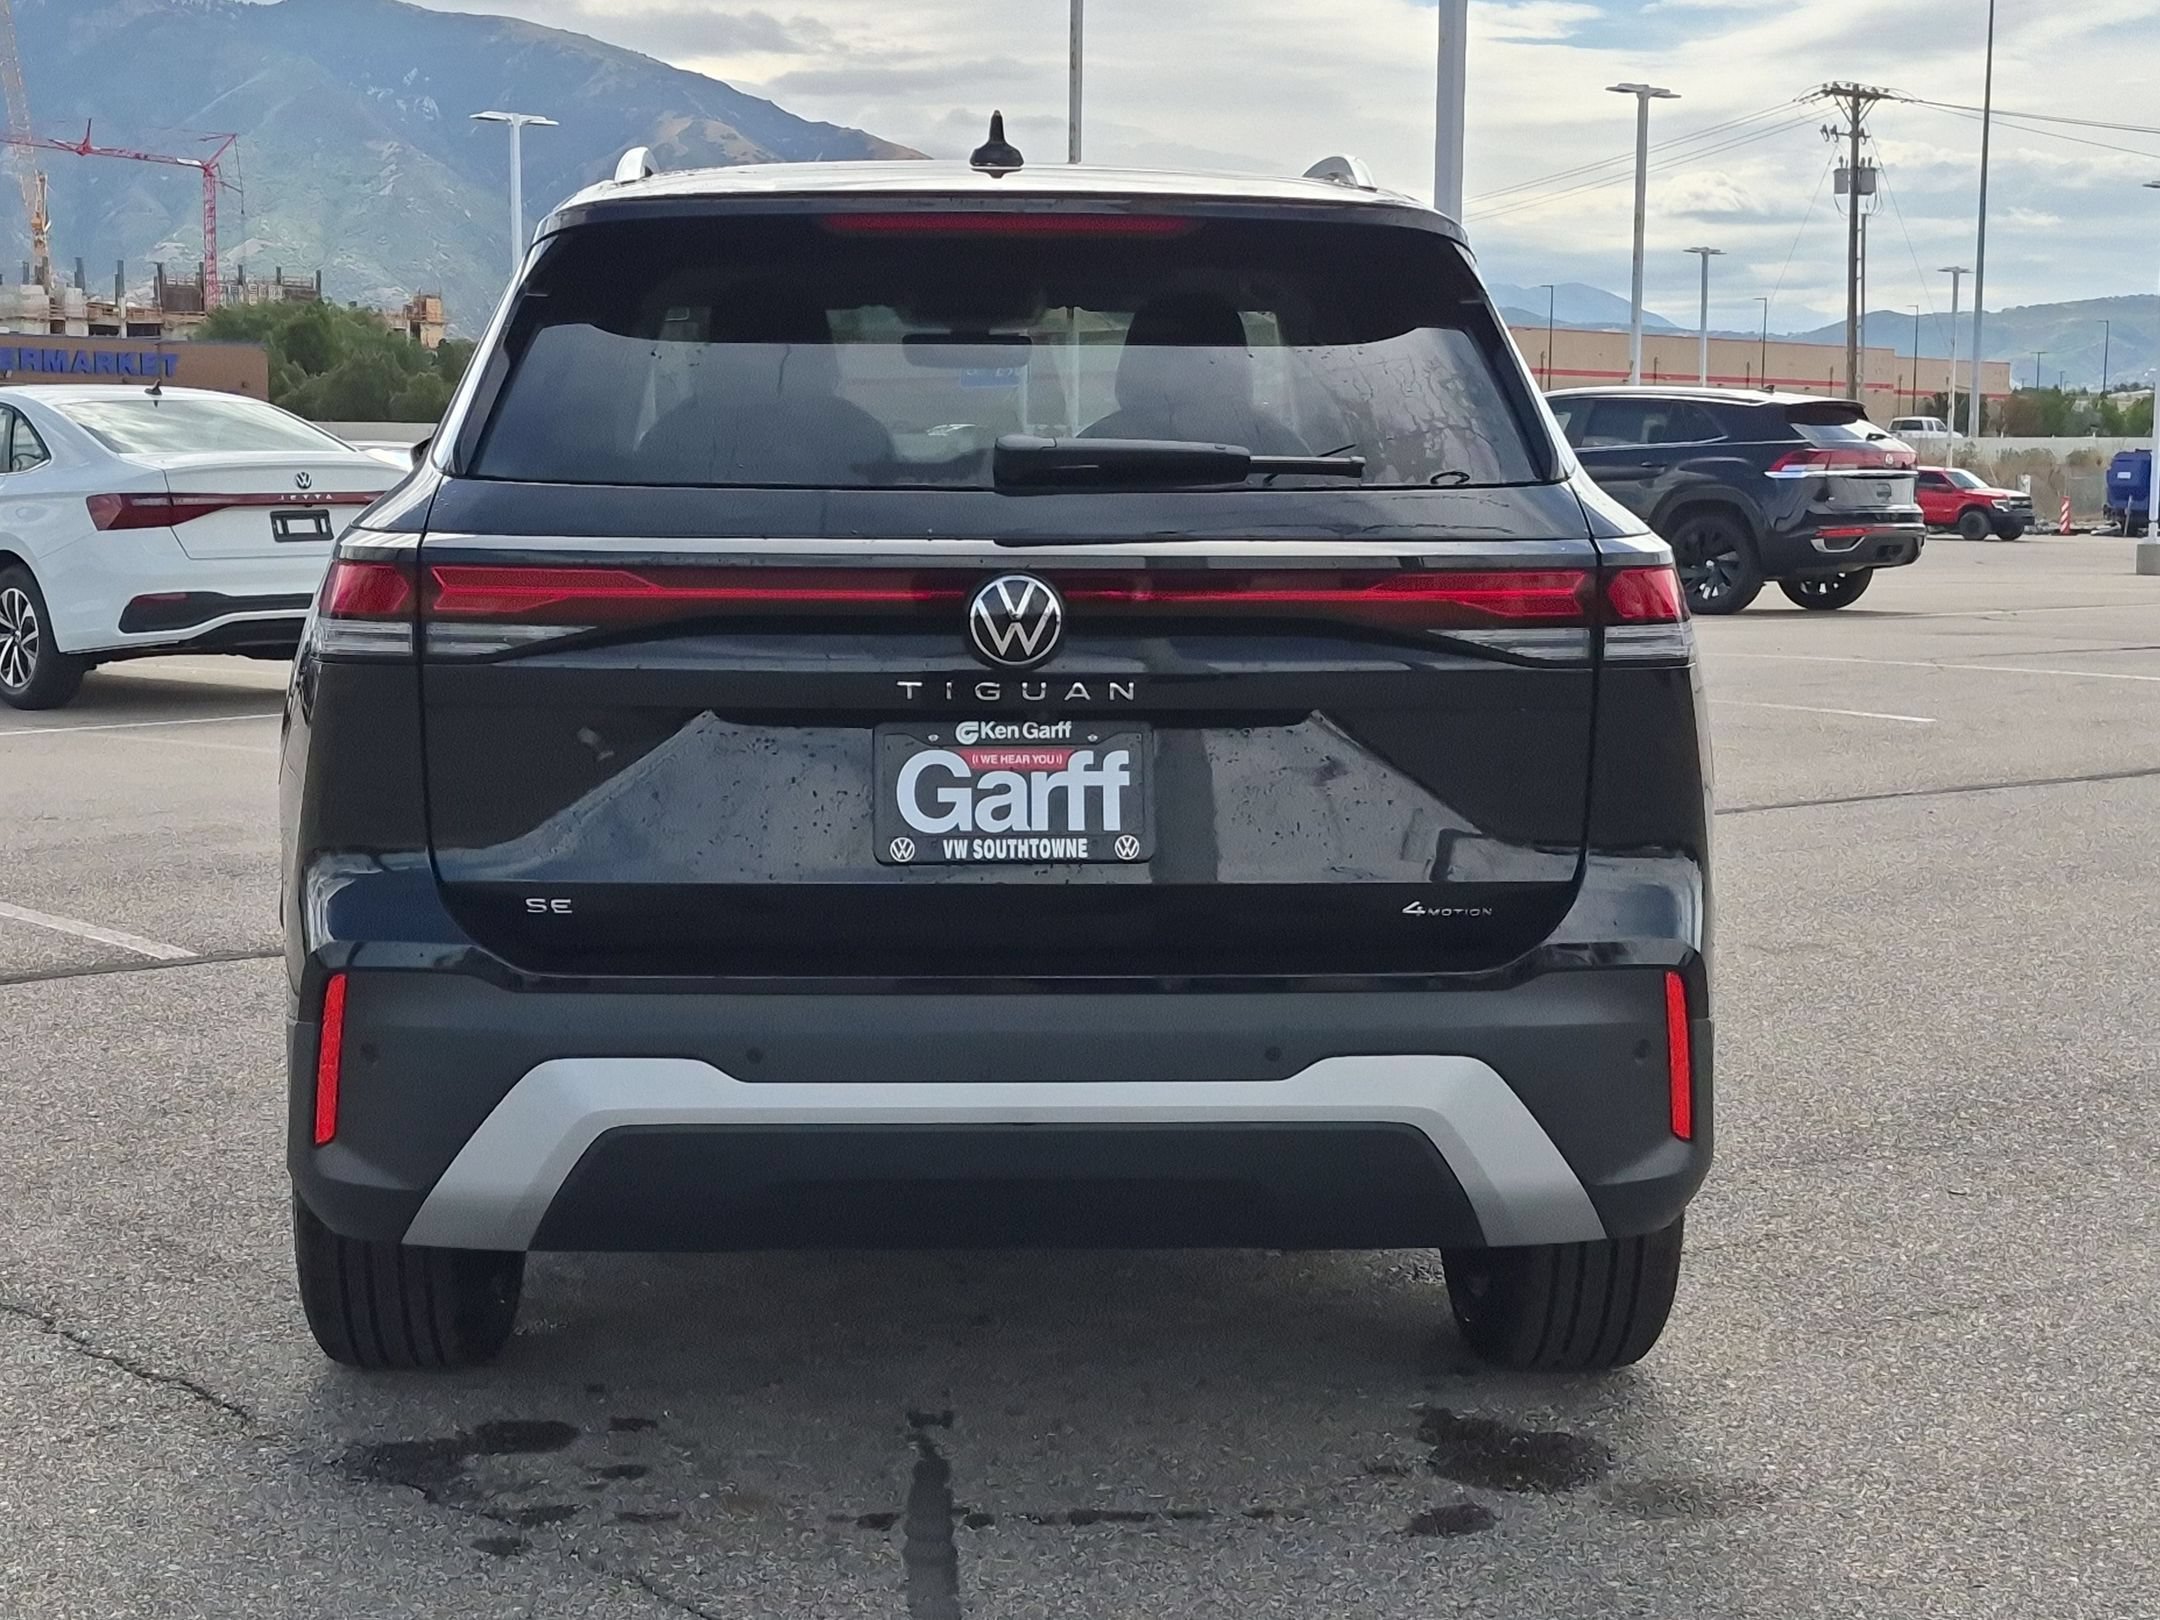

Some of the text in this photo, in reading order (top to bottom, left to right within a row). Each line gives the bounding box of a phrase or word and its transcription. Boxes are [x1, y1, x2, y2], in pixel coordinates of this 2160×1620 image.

[970, 575, 1061, 665] VW
[896, 681, 1135, 701] TIGUAN
[981, 720, 1072, 740] Ken Garff
[980, 755, 1054, 764] WE HEAR YOU
[896, 749, 1130, 834] Garff
[943, 838, 1088, 859] VW SOUTHTOWNE
[525, 898, 573, 913] SE
[1402, 901, 1492, 916] 4MOTION
